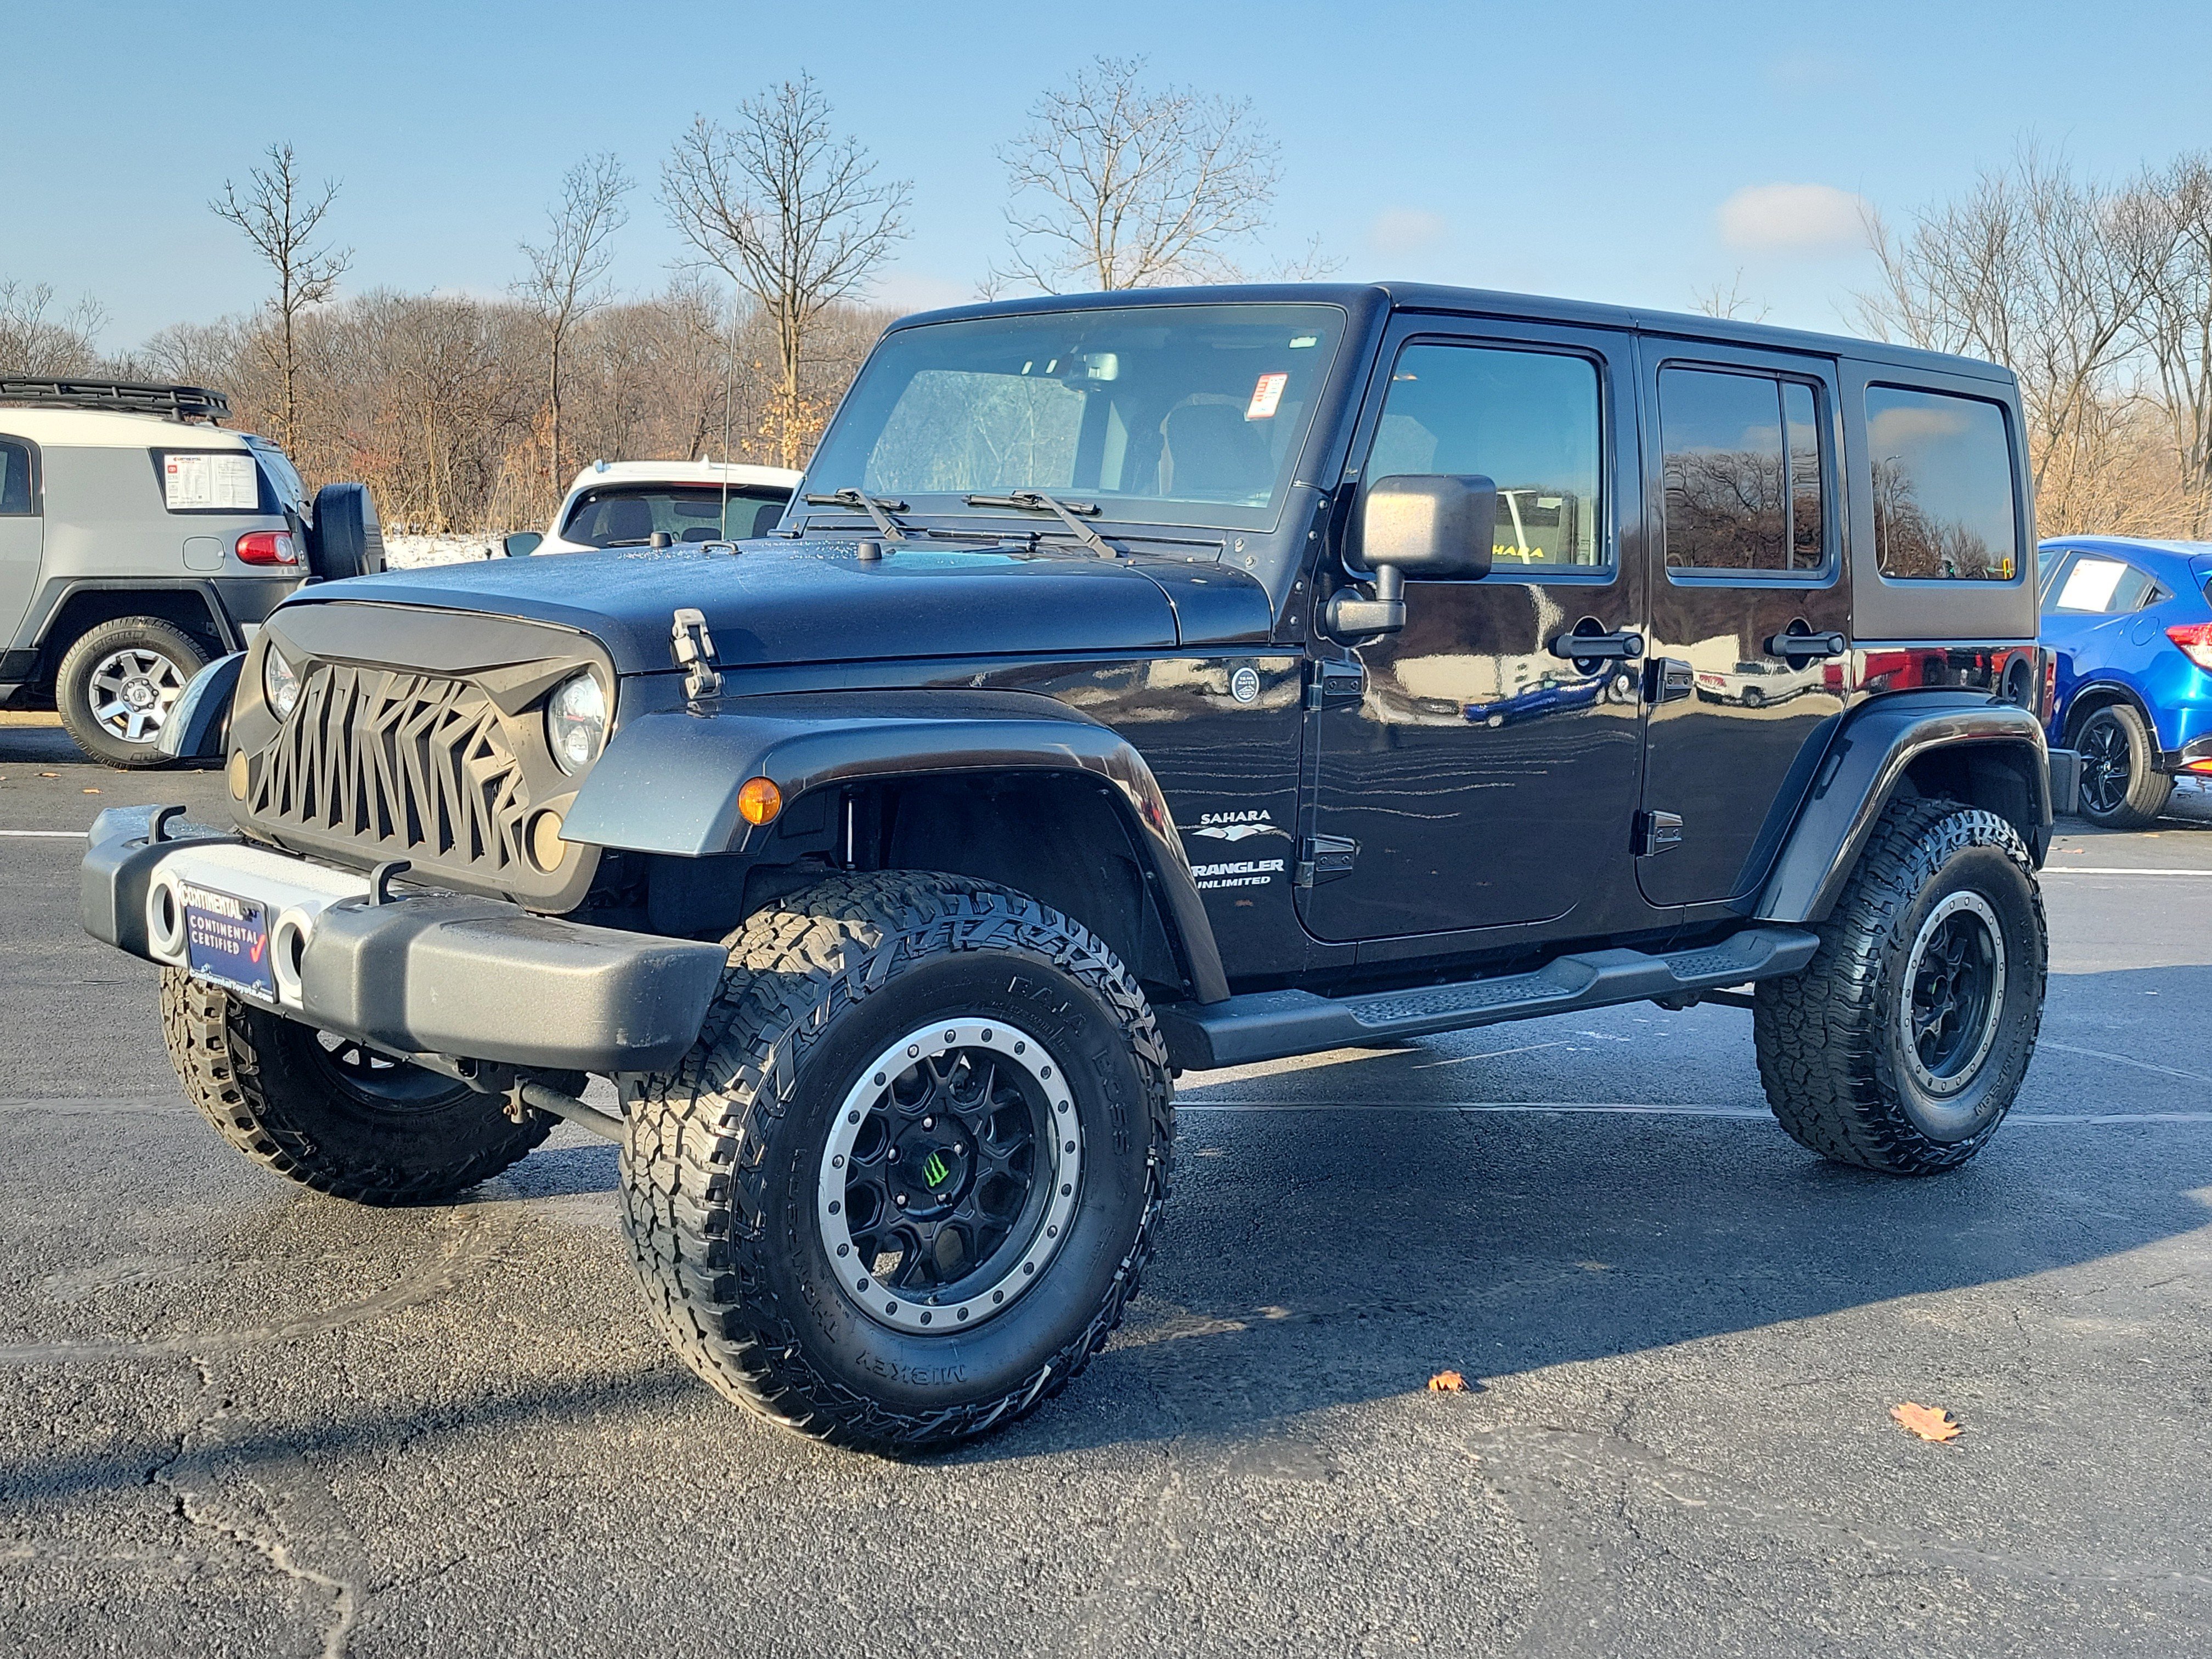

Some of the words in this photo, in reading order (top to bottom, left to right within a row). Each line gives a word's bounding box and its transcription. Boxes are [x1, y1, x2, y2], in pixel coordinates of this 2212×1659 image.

[1200, 809, 1271, 825] SAHARA
[1190, 859, 1284, 877] RANGLER
[180, 883, 244, 921] CONTINENTAL
[189, 915, 258, 945] CONTINENTAL
[191, 930, 240, 955] CERTIFIED
